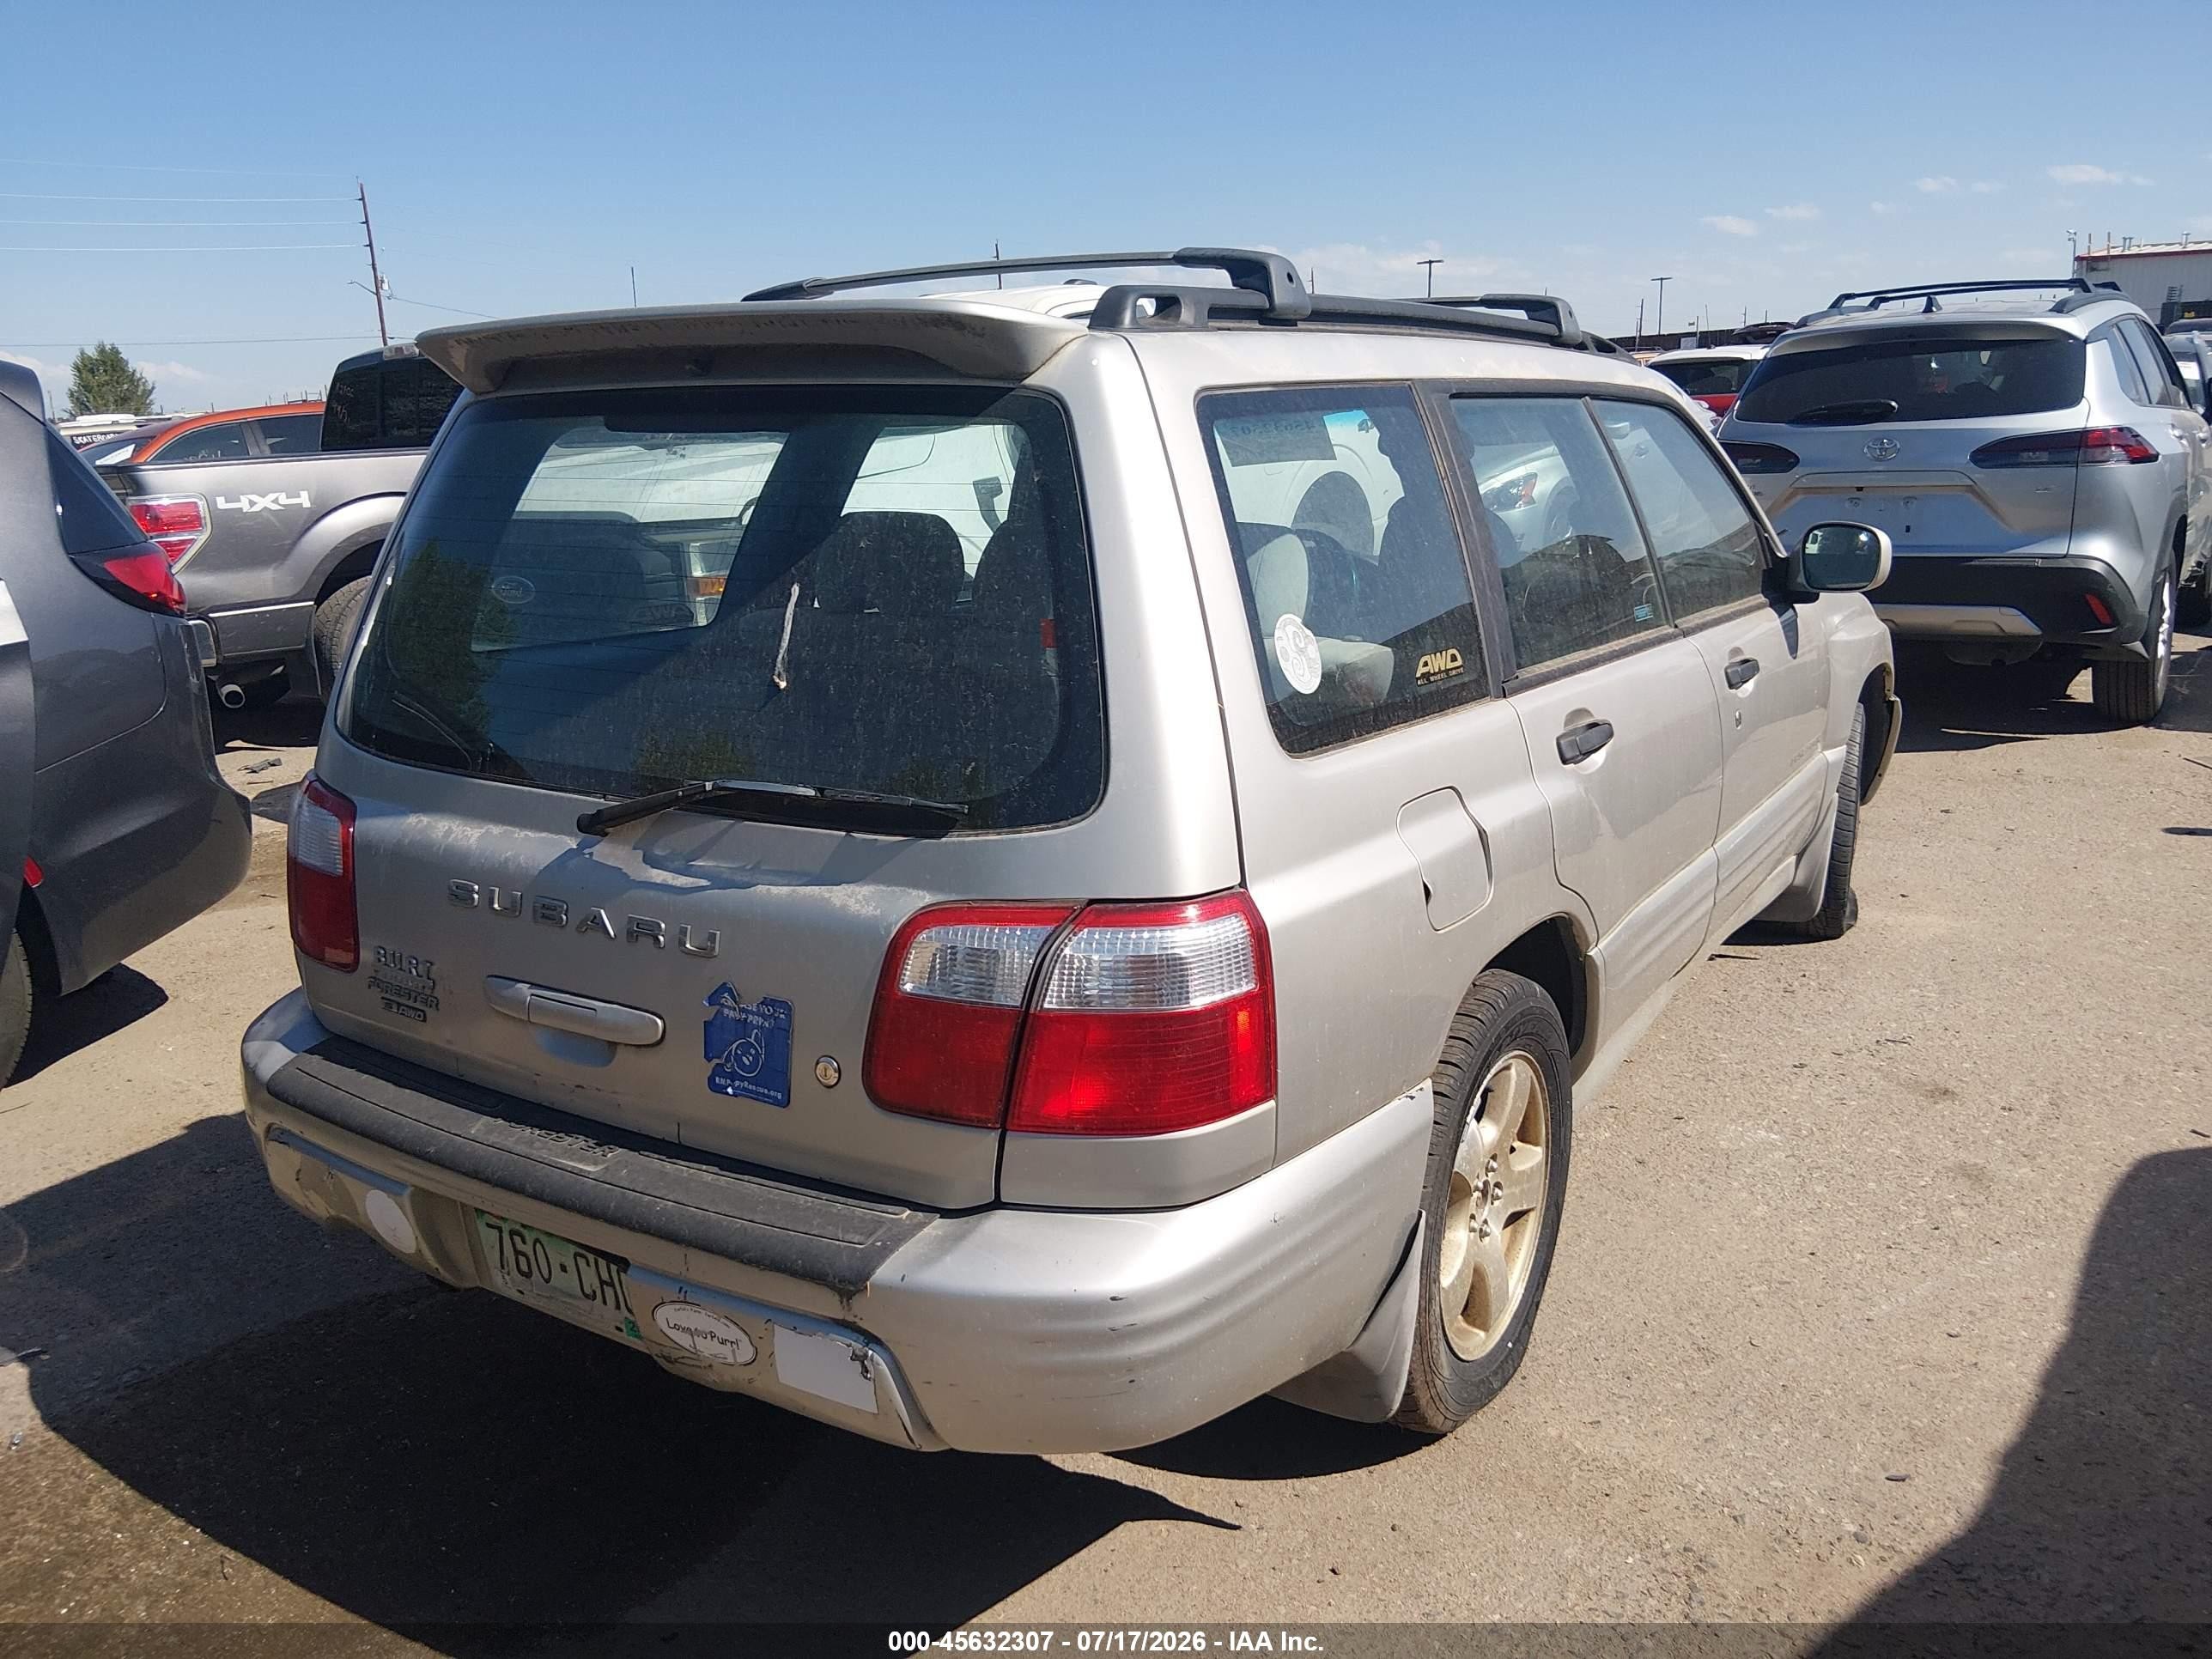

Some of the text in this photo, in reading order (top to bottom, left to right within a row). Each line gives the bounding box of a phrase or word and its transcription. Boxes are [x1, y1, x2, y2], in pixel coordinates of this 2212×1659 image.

[216, 490, 311, 513] 4X4
[1416, 648, 1462, 678] AWD
[447, 878, 720, 958] SUBARU
[368, 975, 441, 1012] FORESTER
